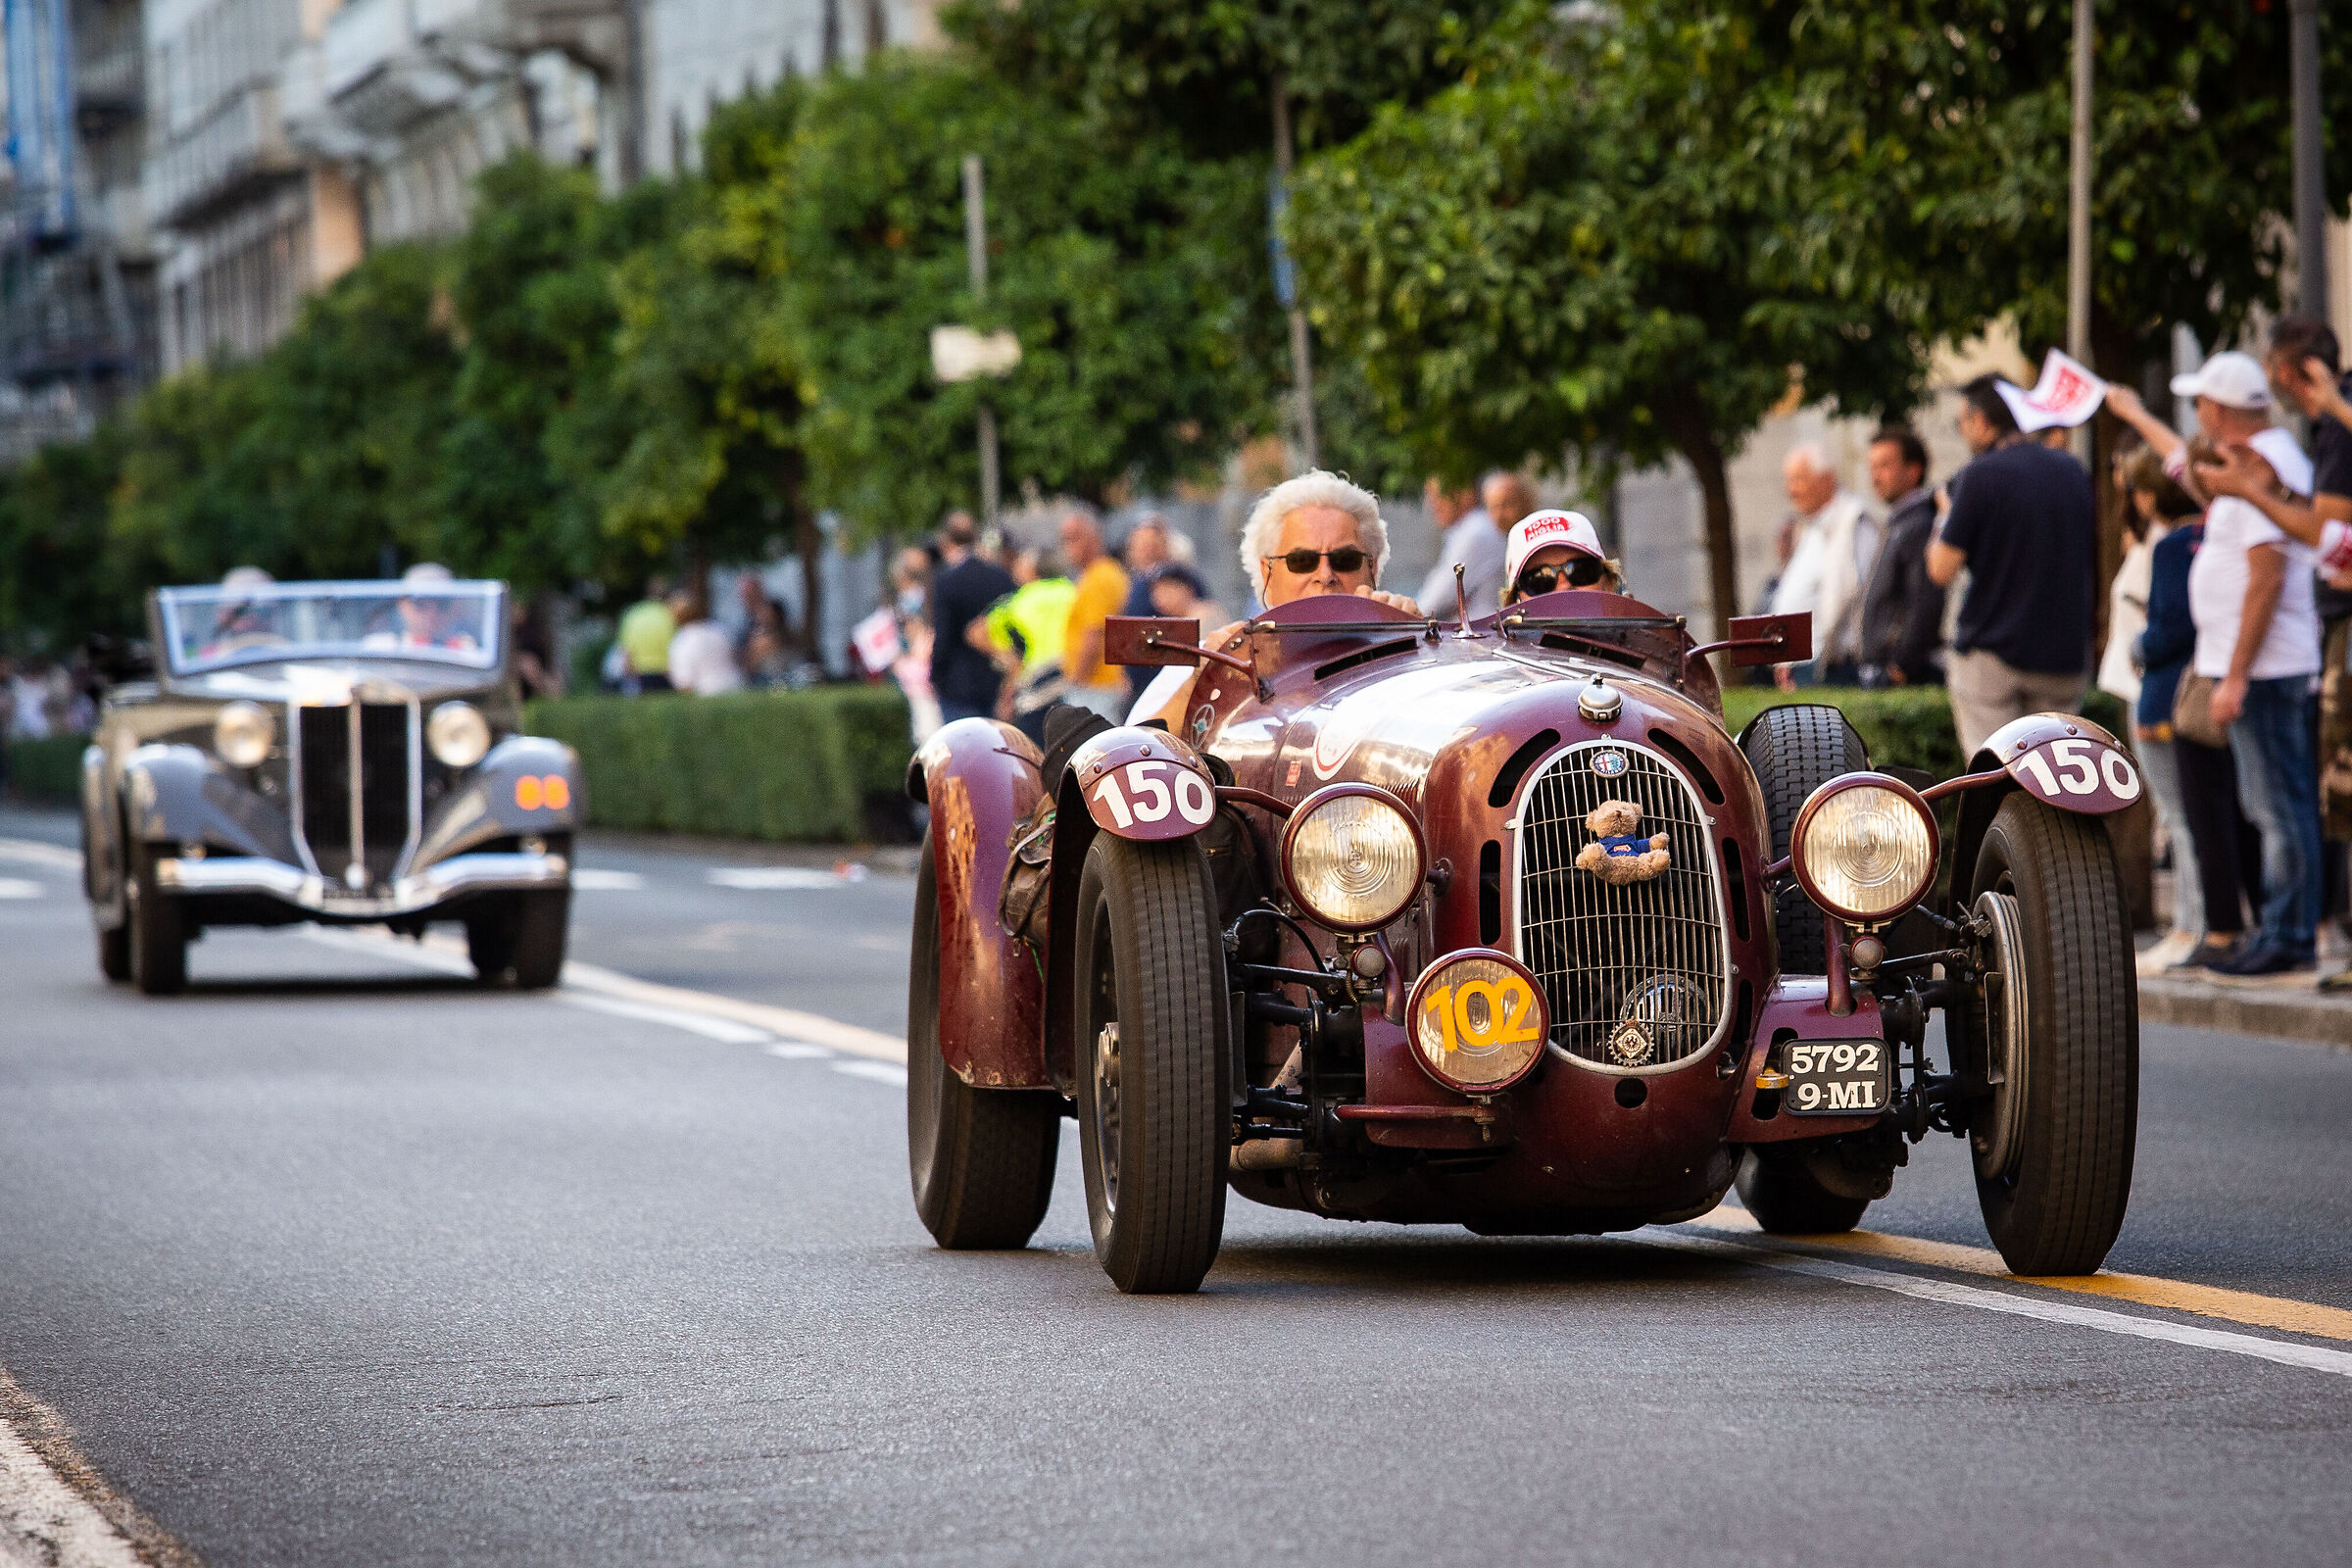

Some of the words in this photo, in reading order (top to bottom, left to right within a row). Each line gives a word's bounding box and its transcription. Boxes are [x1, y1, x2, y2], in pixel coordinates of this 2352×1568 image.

[1527, 523, 1565, 540] MIGLIA
[1528, 517, 1560, 531] 1000
[2016, 739, 2140, 800] 150
[1092, 760, 1214, 829] 150
[1426, 975, 1540, 1052] 102
[1790, 1043, 1881, 1074] 5792
[1797, 1081, 1877, 1110] 9-MI
